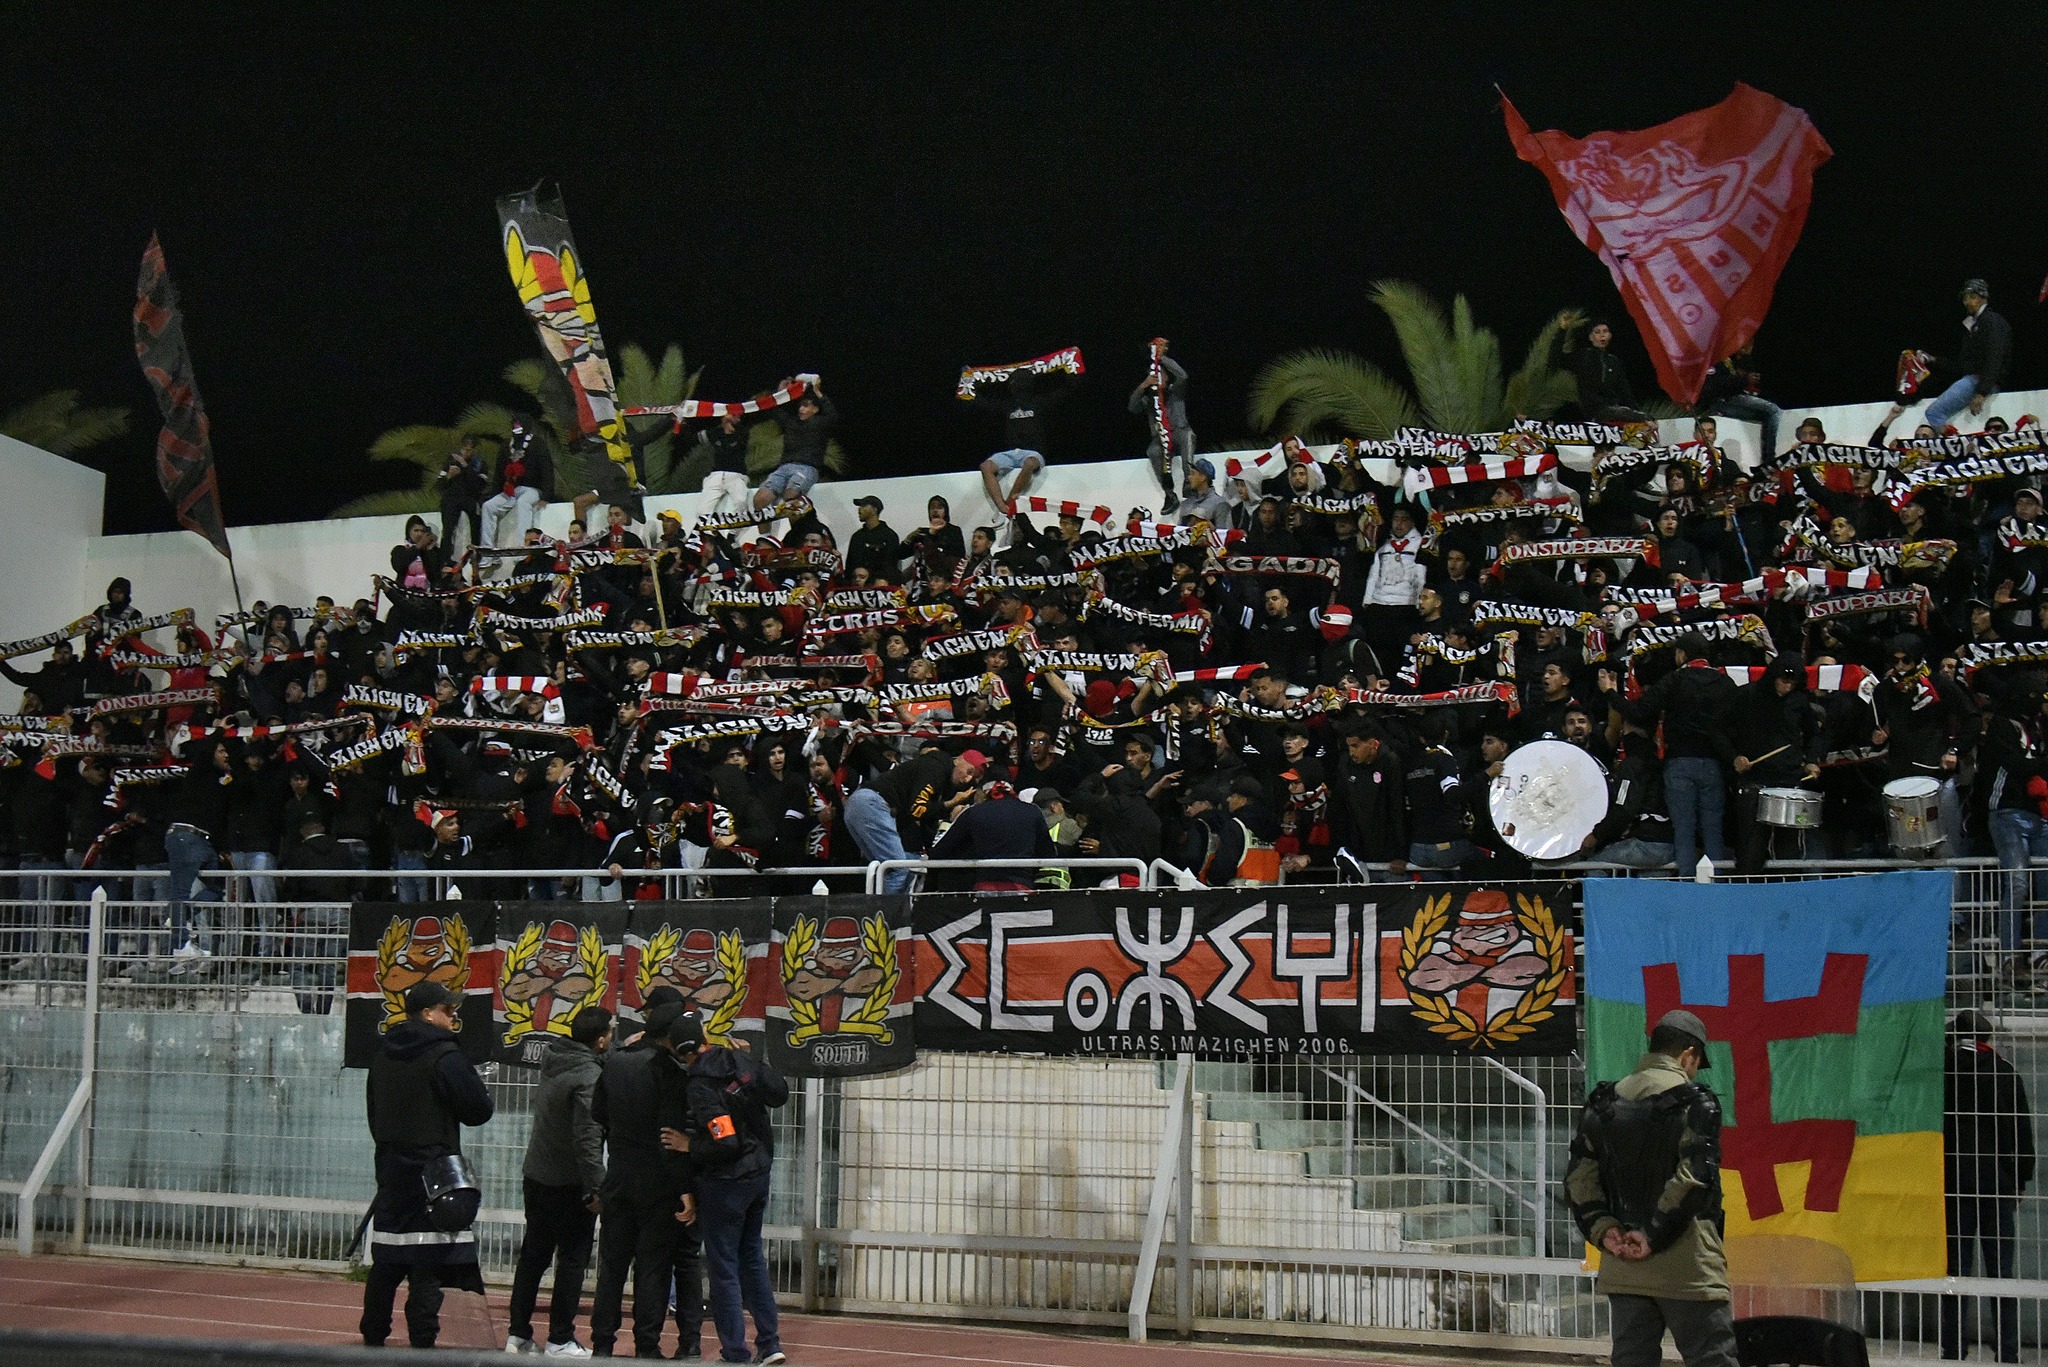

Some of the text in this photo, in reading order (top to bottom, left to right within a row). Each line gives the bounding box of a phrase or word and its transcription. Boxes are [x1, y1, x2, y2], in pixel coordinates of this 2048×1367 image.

[1082, 1035, 1160, 1051] ULTRAS
[1171, 1036, 1290, 1052] IMAZIGHEN
[814, 1042, 868, 1066] SOUTH
